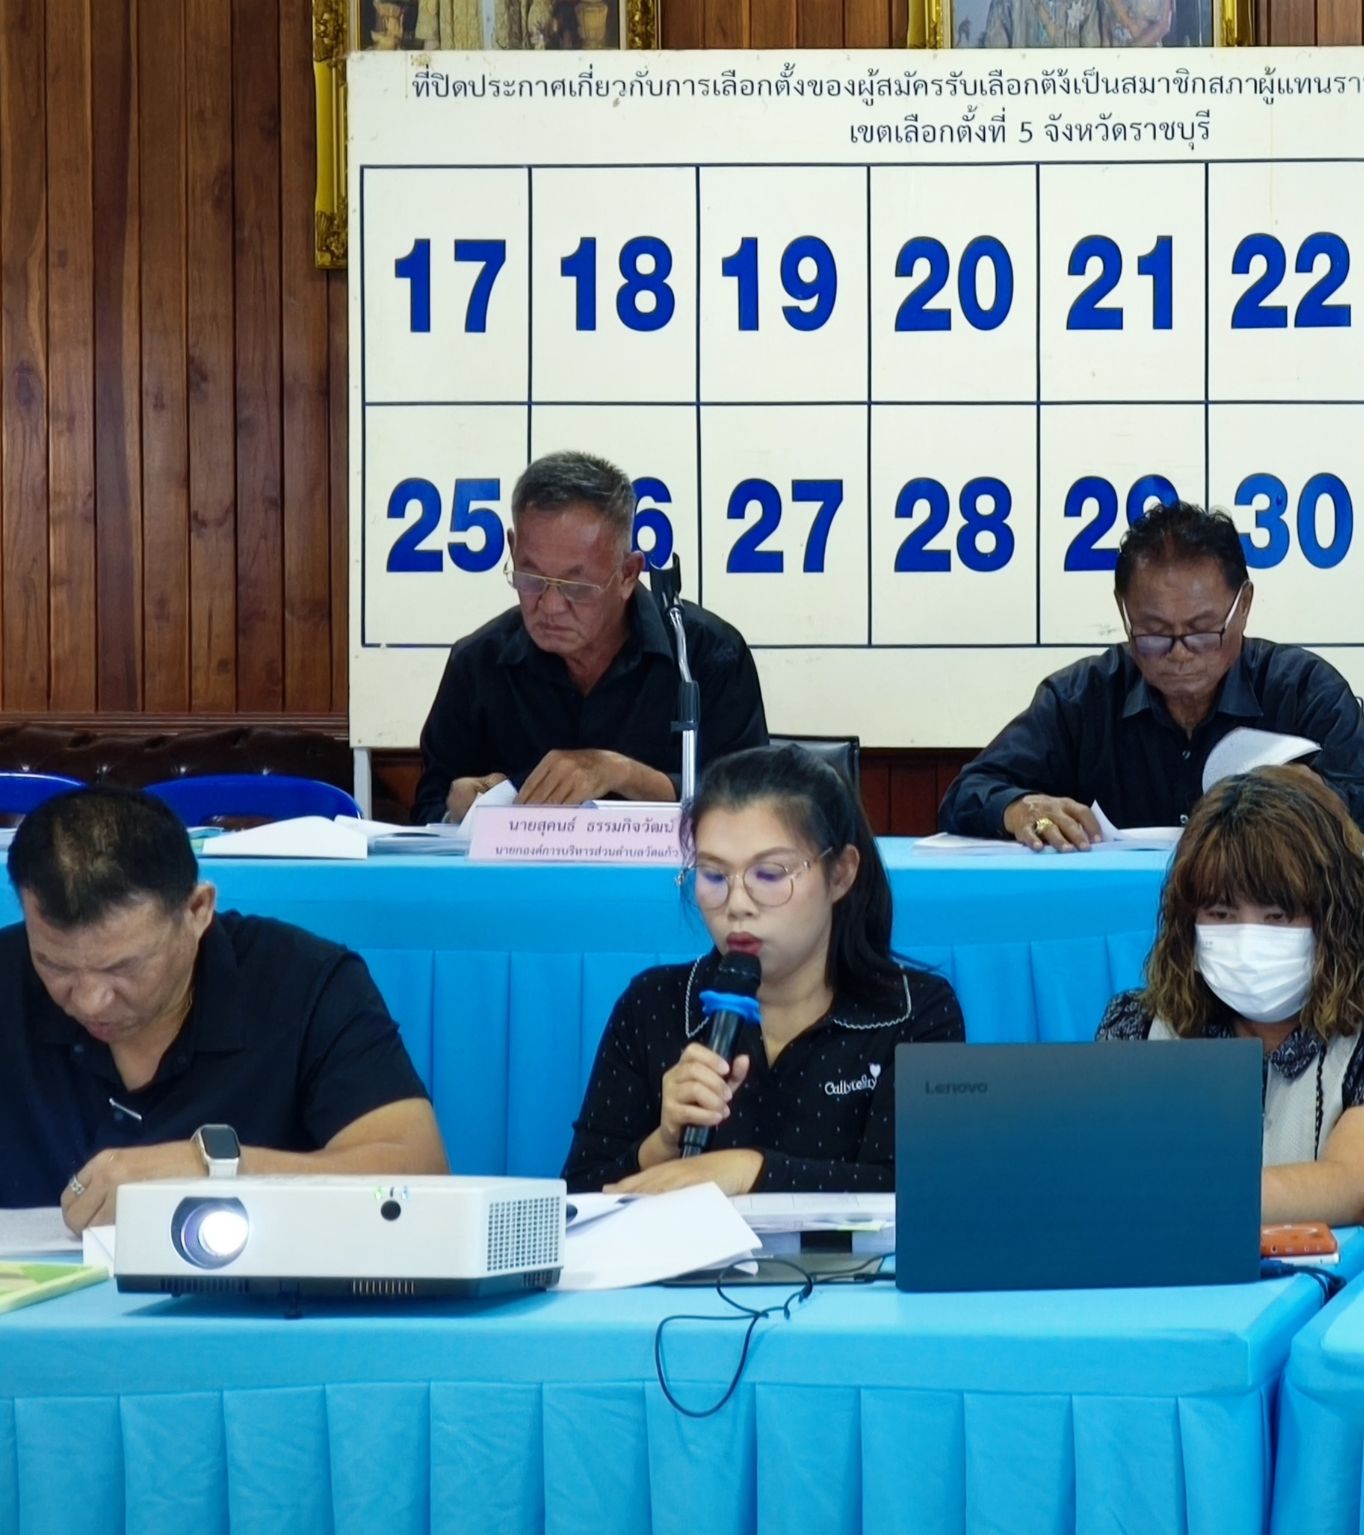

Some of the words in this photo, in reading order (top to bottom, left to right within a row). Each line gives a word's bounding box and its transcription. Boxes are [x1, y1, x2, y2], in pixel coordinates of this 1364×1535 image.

[850, 105, 1006, 144] เขตเลือกตั้งที่
[1019, 121, 1033, 143] 5
[1044, 109, 1210, 151] จังหวัดราชบุรี
[395, 238, 506, 332] 17
[560, 236, 675, 331] 18
[721, 236, 837, 331] 19
[895, 235, 1013, 331] 20
[1066, 234, 1173, 330] 21
[1231, 232, 1351, 328] 22
[386, 477, 505, 573] 25
[631, 476, 674, 572] 6
[726, 478, 844, 573] 27
[894, 477, 1015, 572] 28
[1234, 472, 1353, 569] 30
[925, 1079, 988, 1096] Lenovo
